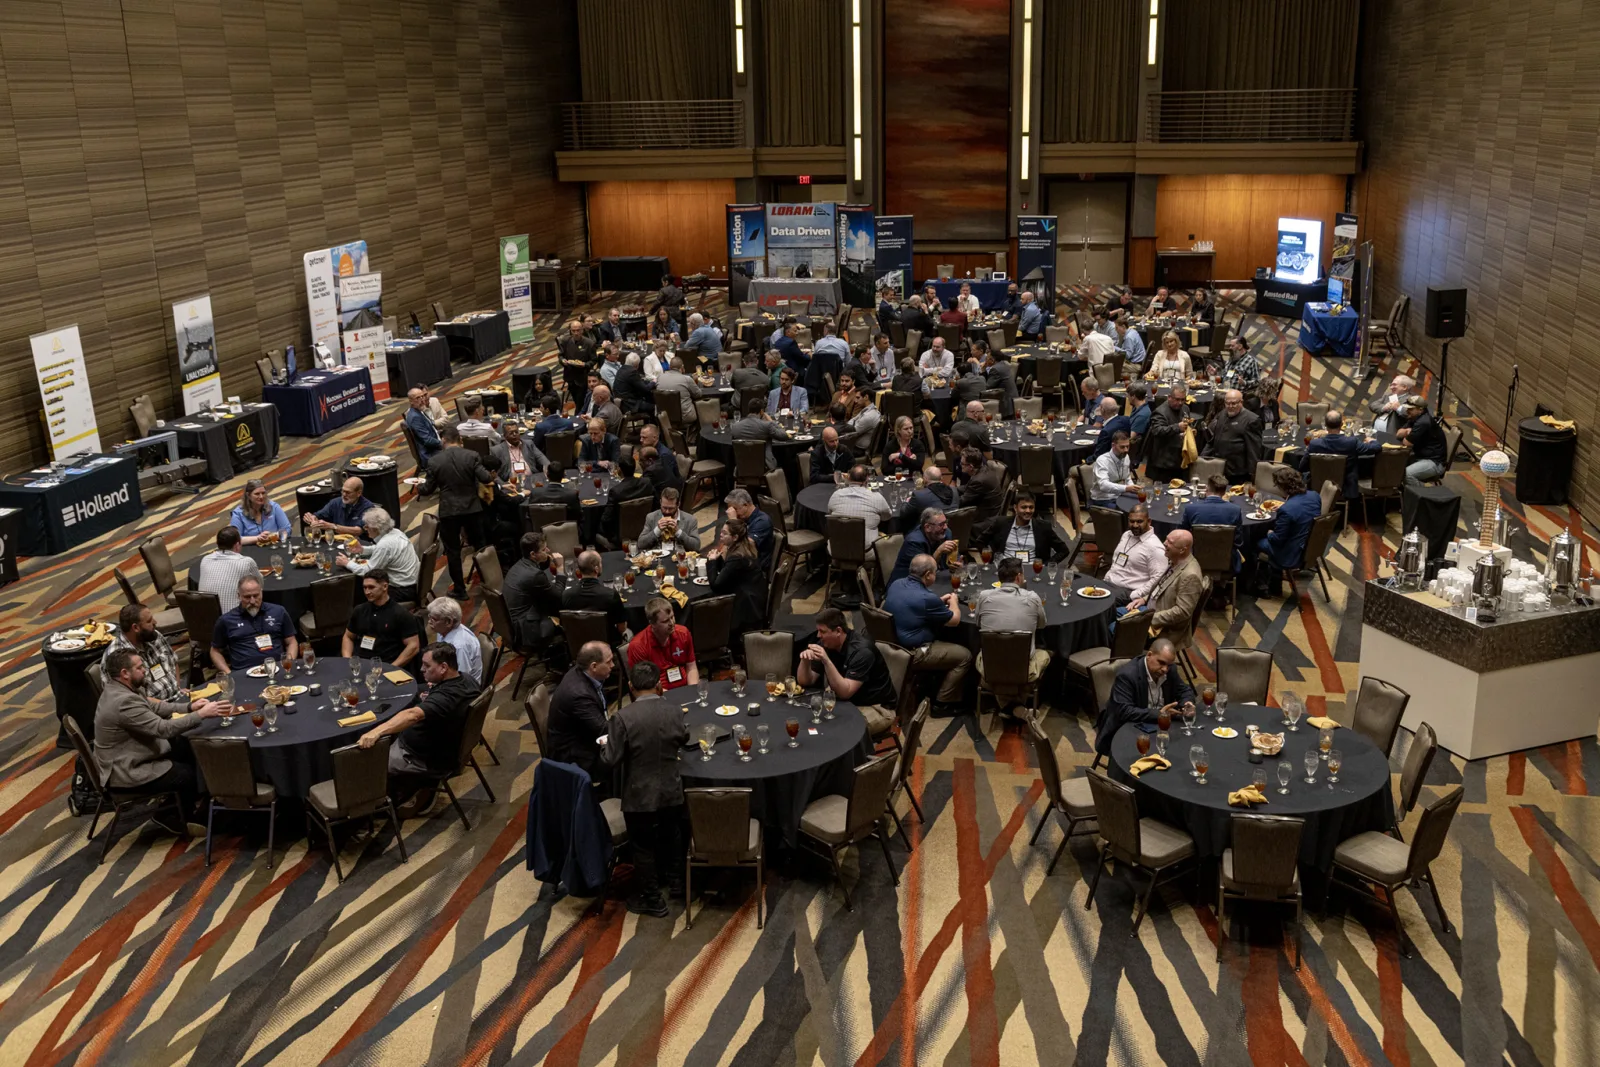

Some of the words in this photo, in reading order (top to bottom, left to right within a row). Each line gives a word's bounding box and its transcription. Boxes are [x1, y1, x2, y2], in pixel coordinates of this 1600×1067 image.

[800, 176, 810, 184] EXIT
[771, 206, 814, 216] LORAM
[733, 214, 742, 256] Friction
[771, 226, 796, 236] Data
[798, 226, 831, 236] Driven
[1264, 290, 1285, 299] Amsted
[1286, 292, 1298, 301] Rail
[75, 484, 129, 522] Holland
